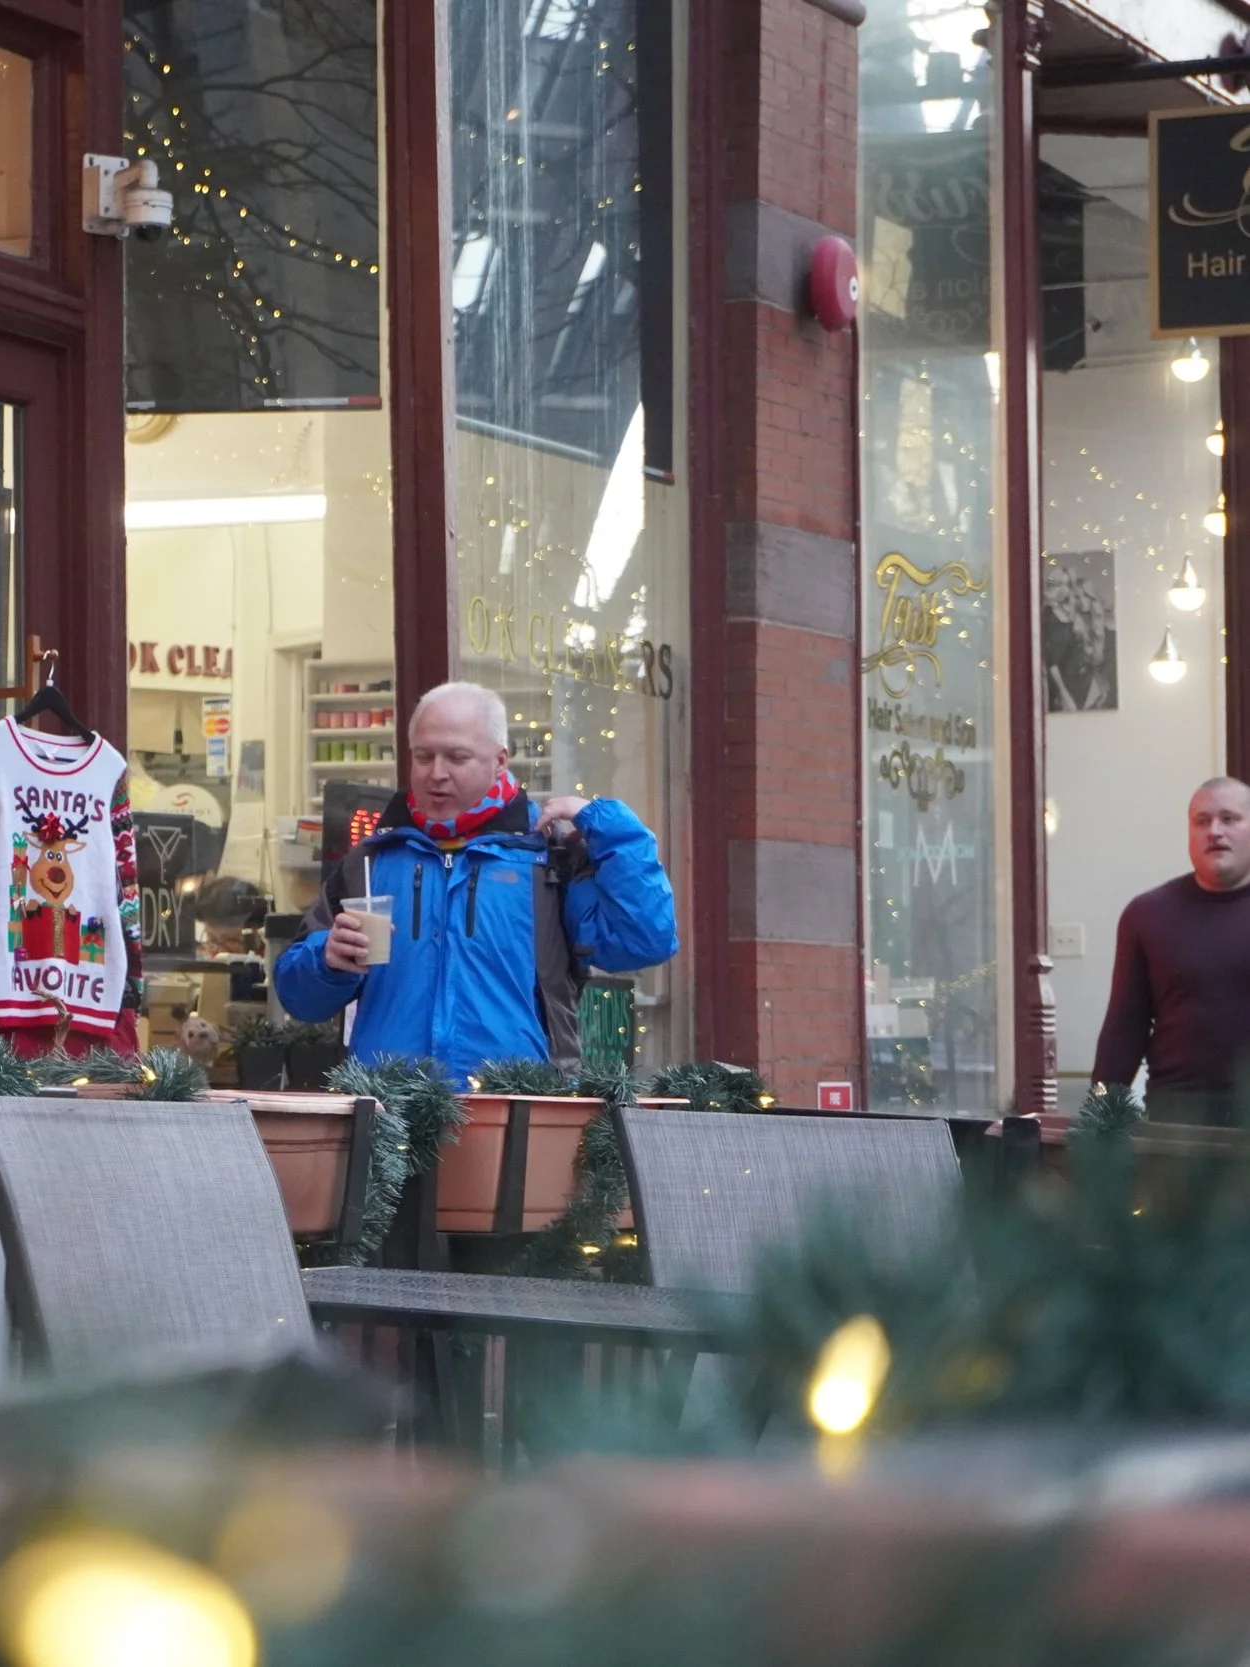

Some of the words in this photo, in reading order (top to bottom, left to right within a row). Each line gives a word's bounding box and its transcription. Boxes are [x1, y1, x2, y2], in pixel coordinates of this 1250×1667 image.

[1187, 250, 1246, 279] Hair
[527, 612, 673, 700] CLEANRS
[13, 785, 105, 822] SANTA'S
[11, 964, 105, 1005] AVOITE
